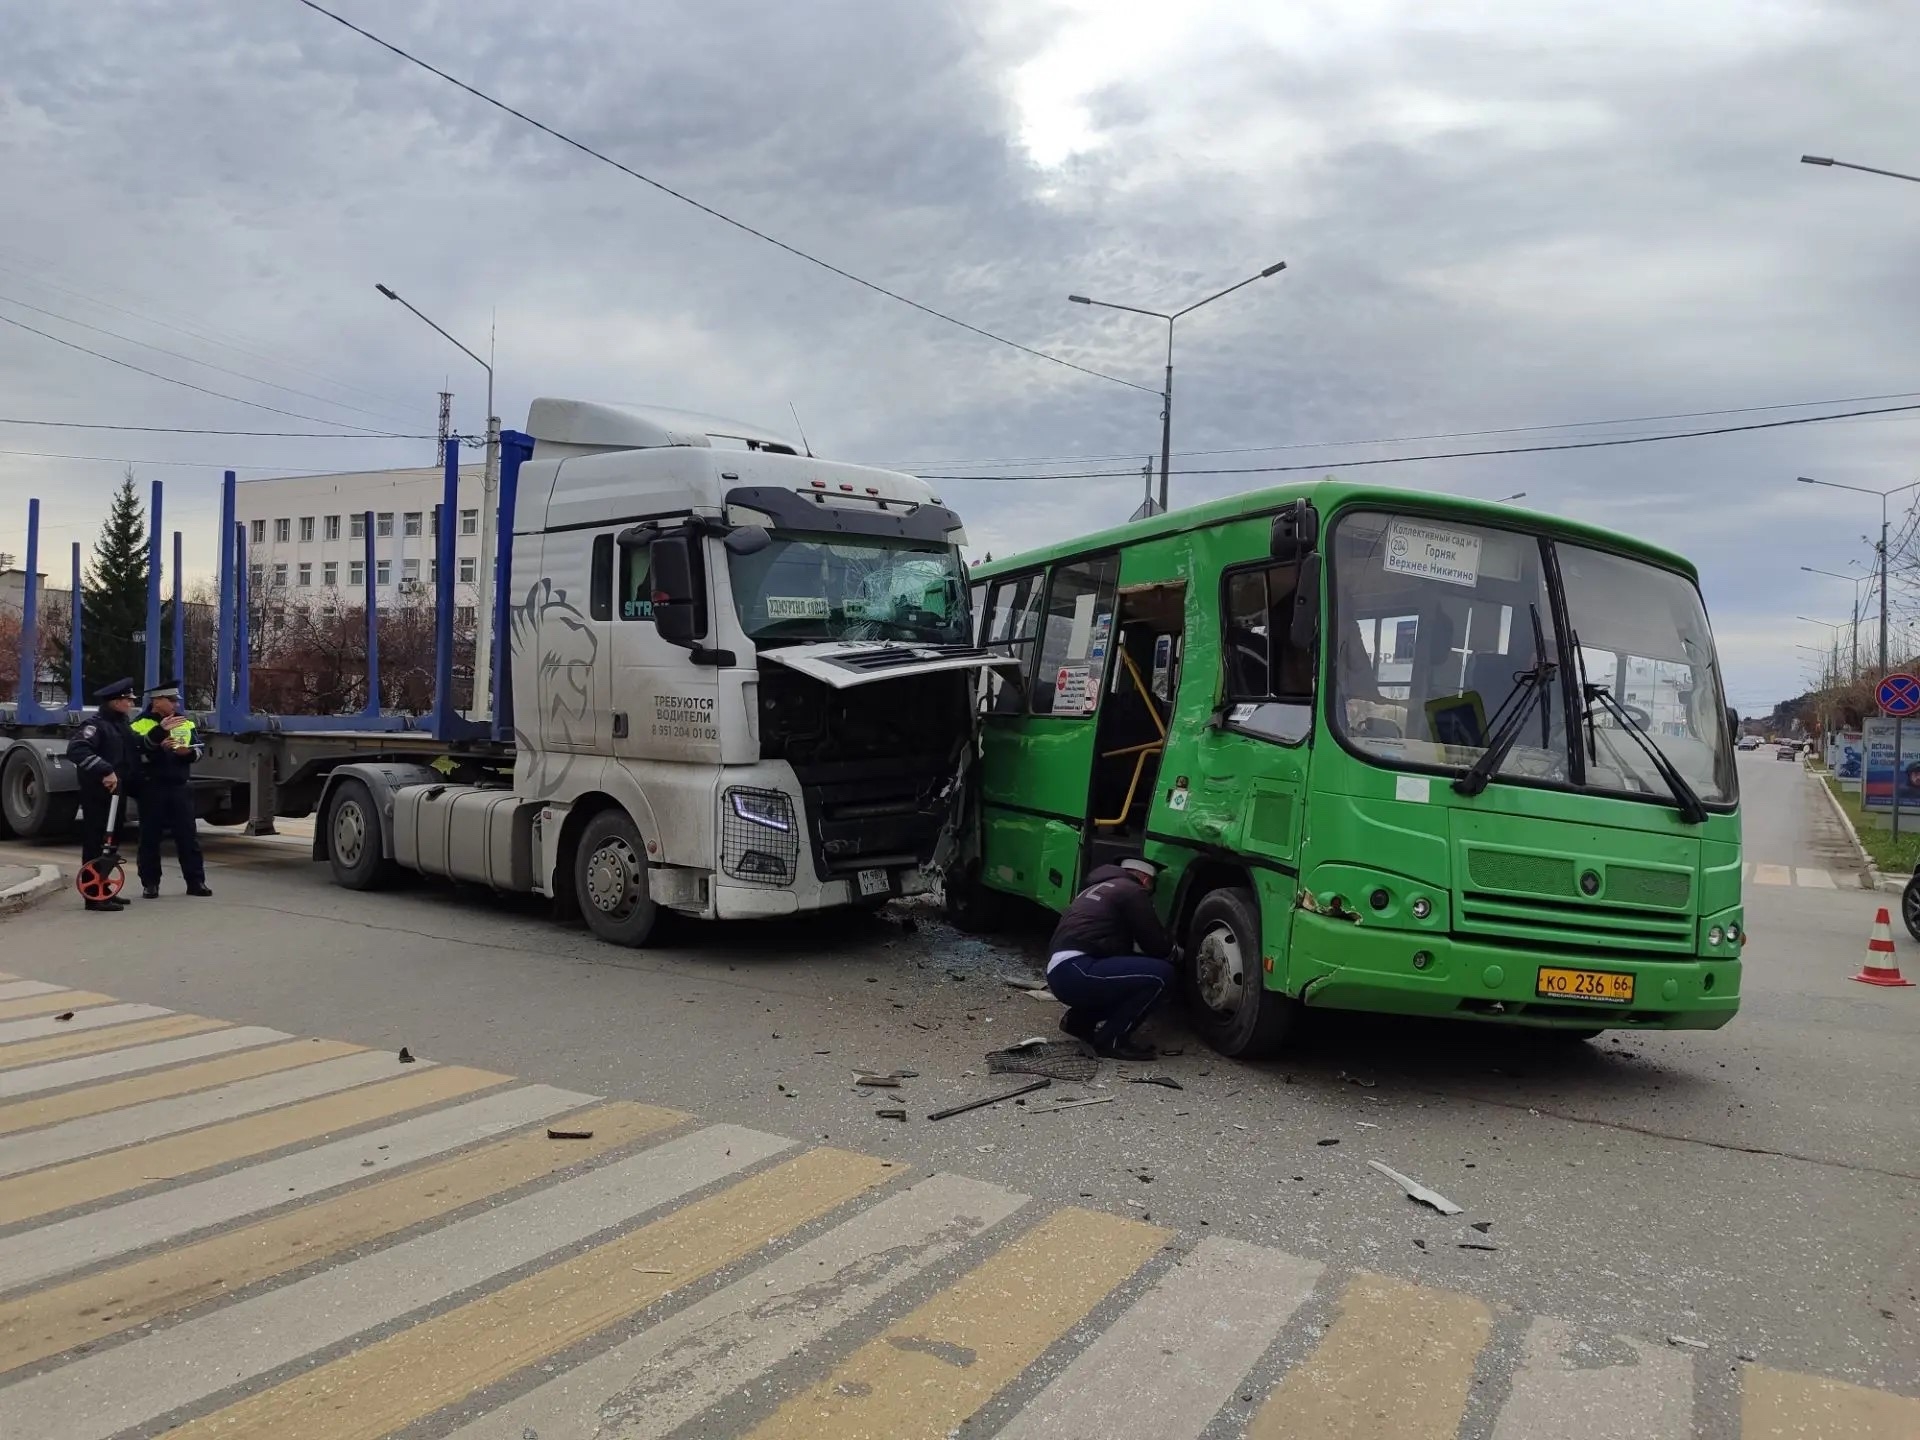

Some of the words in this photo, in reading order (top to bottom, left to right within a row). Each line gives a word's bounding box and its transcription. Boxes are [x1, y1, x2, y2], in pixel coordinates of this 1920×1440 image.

[1393, 524, 1451, 543] Коллективный
[1452, 536, 1465, 548] сад
[1425, 544, 1457, 560] Горняк
[1389, 556, 1428, 572] Верхнее
[1430, 563, 1474, 580] Никитино
[624, 601, 654, 617] SITR
[654, 695, 714, 710] ТРЕБУЮТСЯ
[656, 708, 711, 723] ВОДИТЕЛИ
[692, 727, 702, 738] 01
[704, 728, 717, 740] 02
[1546, 976, 1567, 991] КО
[1575, 974, 1605, 994] 236
[1613, 976, 1628, 992] 66
